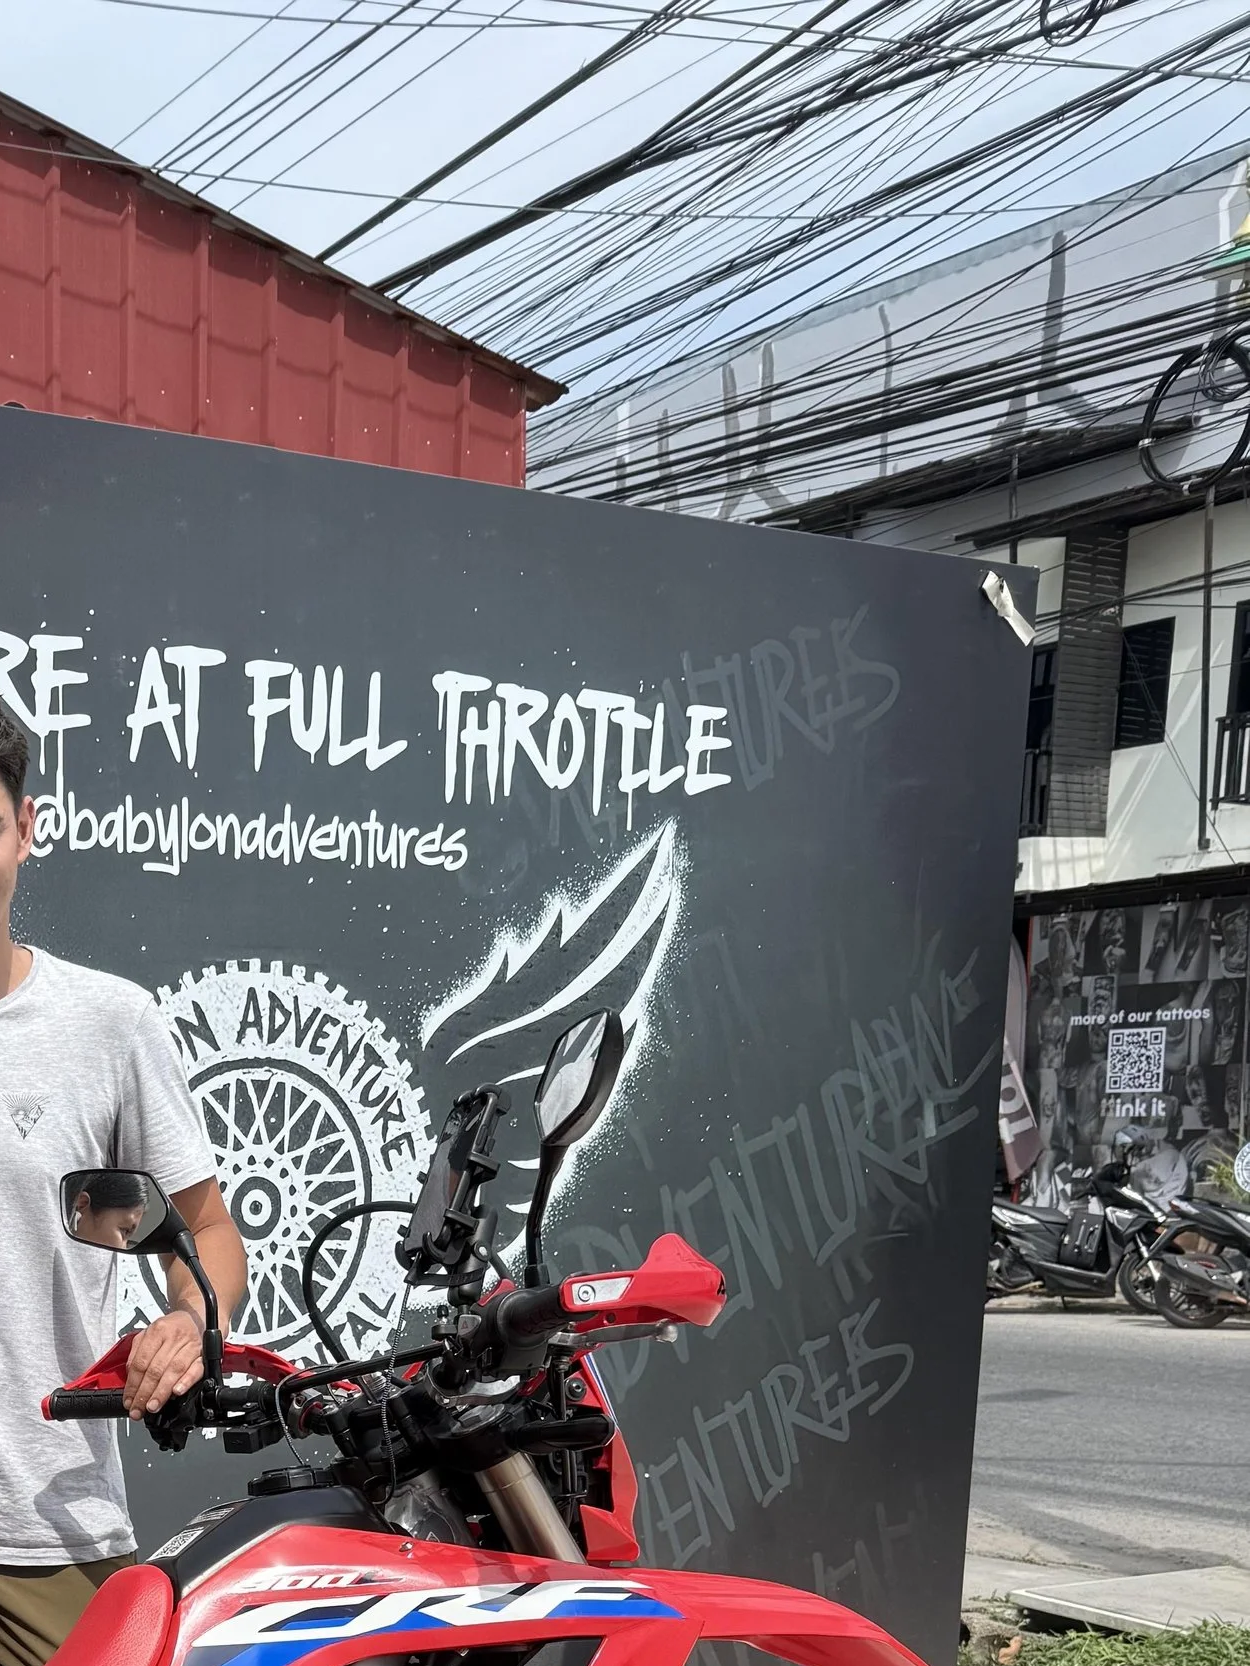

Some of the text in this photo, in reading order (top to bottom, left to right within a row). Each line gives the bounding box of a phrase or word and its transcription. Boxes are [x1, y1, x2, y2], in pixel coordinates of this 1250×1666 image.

[126, 645, 227, 770] AT
[244, 659, 408, 772] FULL
[29, 793, 469, 875] @babylonadventures
[1070, 1007, 1211, 1027] more of our tattoos
[236, 986, 417, 1172] ADVENTURE
[1151, 1097, 1167, 1118] it
[192, 1580, 655, 1648] CRF
